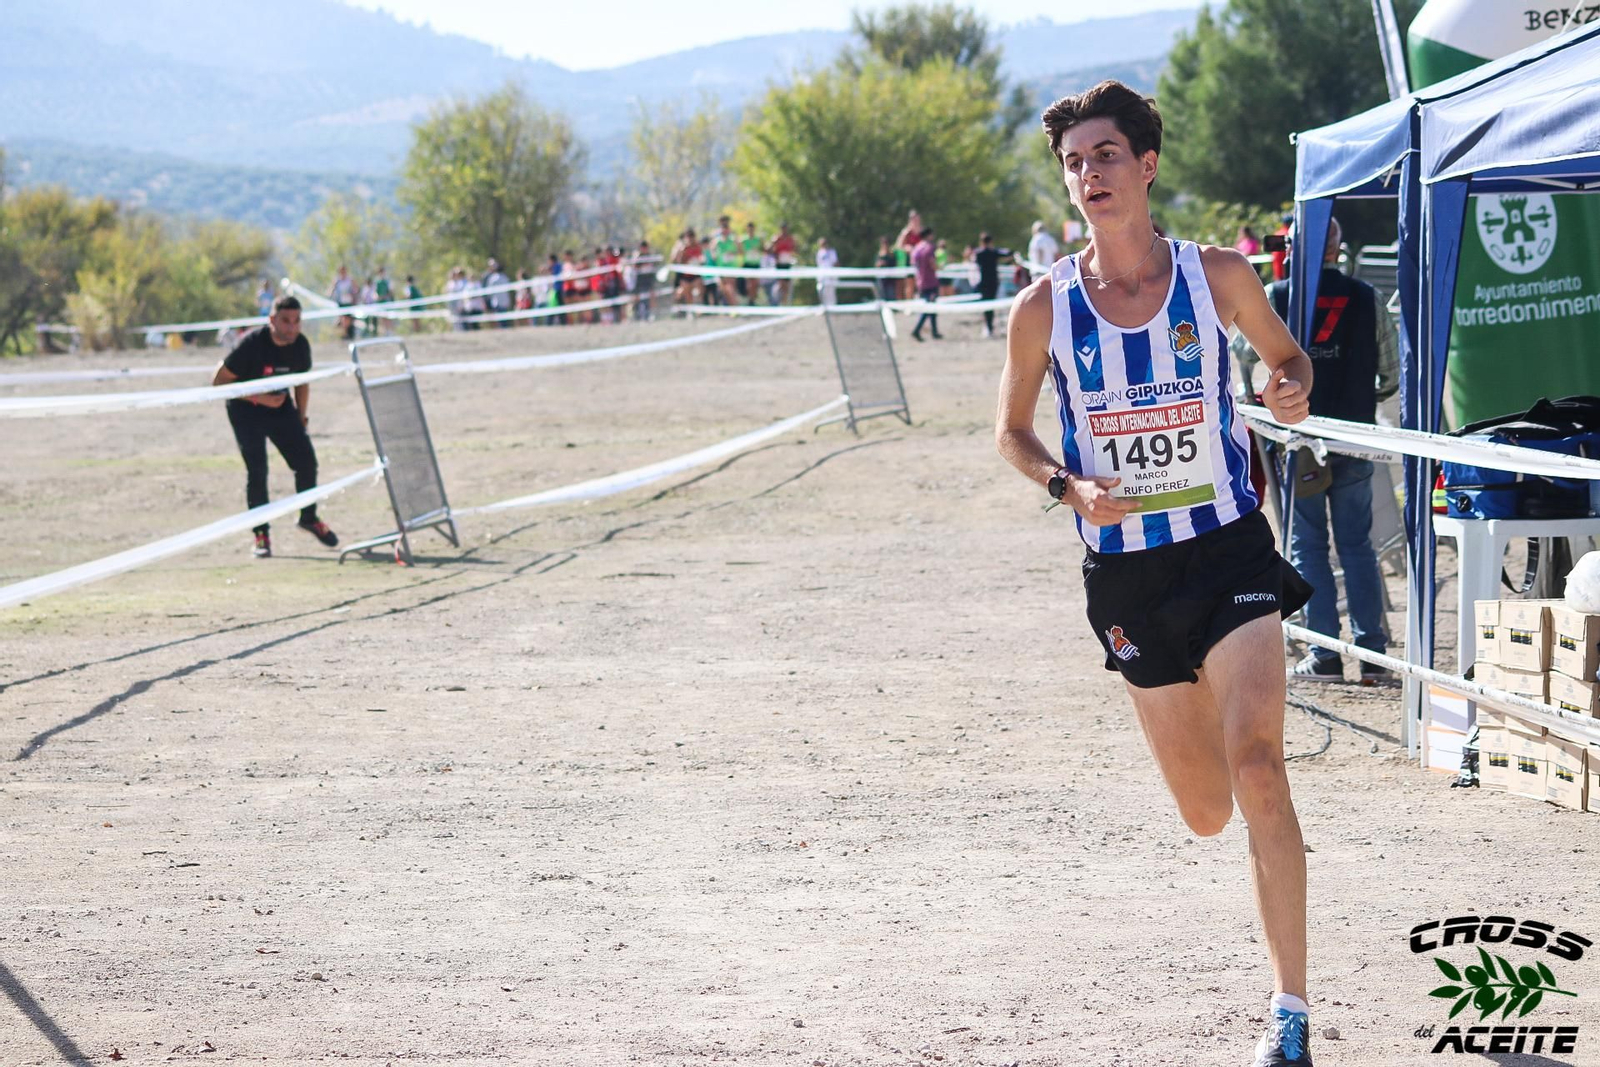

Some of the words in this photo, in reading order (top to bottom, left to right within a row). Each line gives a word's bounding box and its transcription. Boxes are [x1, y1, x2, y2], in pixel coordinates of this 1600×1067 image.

[1473, 275, 1582, 304] Ayuntamiento
[1314, 296, 1350, 342] 7
[1081, 390, 1122, 405] ORAIN
[1125, 379, 1204, 399] GIPUZKOA
[1100, 415, 1119, 433] CROSS
[1119, 409, 1168, 432] INTERNACIONAL
[1168, 408, 1180, 425] DEL
[1181, 403, 1201, 423] ACEITE
[1102, 428, 1198, 472] 1495
[1124, 484, 1153, 495] RUFO
[1156, 479, 1190, 492] PEREZ
[1134, 470, 1168, 481] MARCO
[1234, 592, 1276, 604] macron
